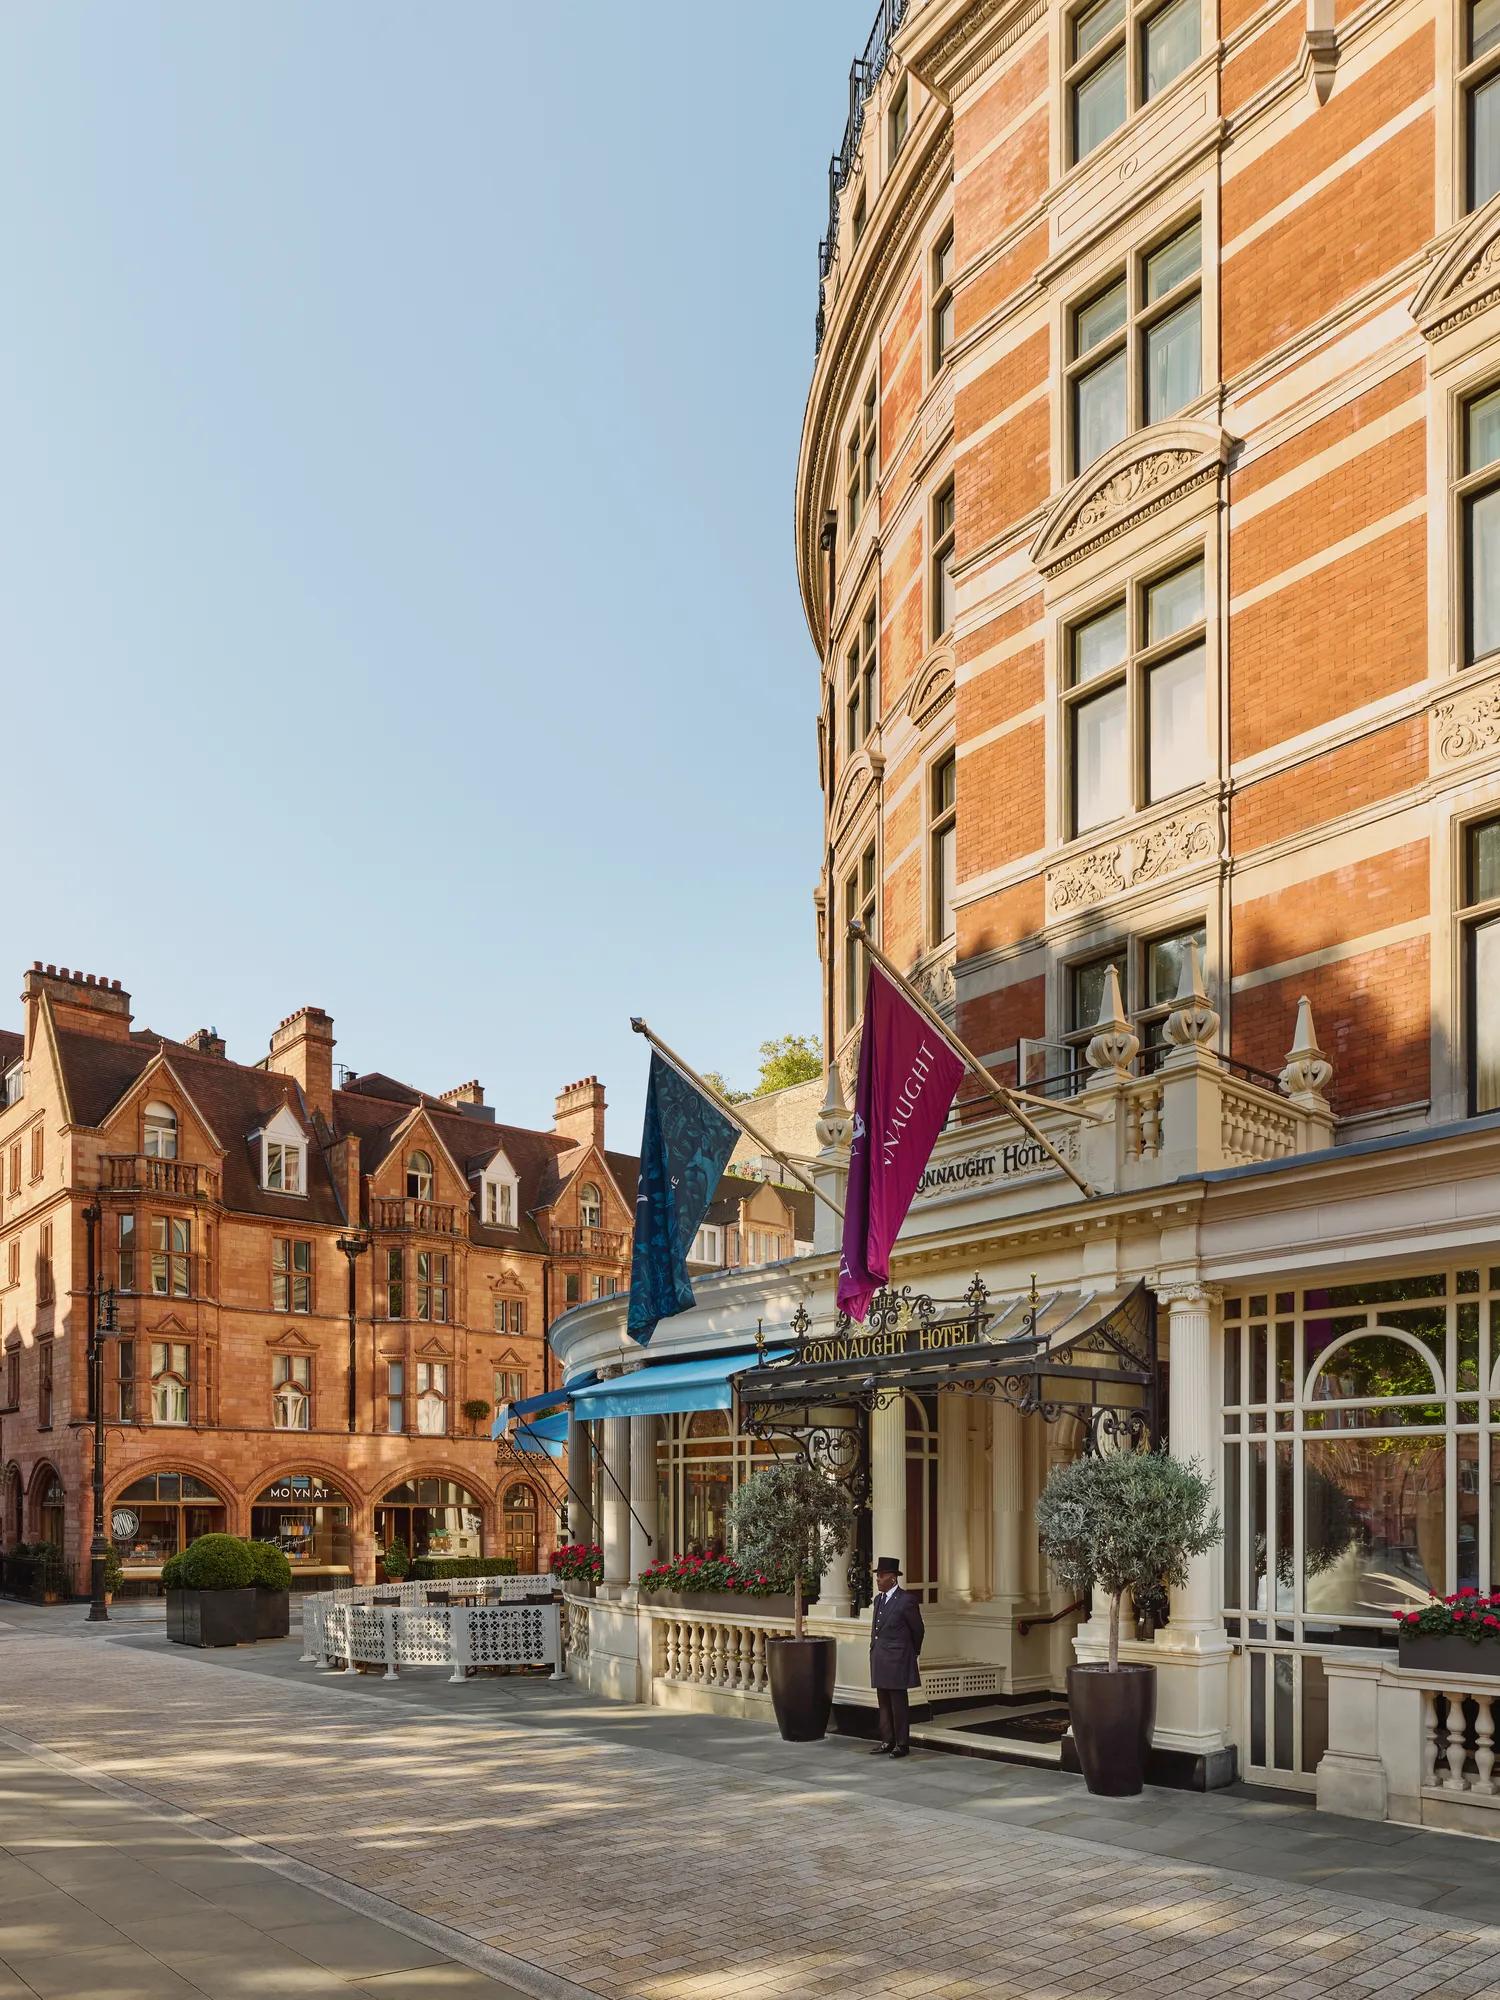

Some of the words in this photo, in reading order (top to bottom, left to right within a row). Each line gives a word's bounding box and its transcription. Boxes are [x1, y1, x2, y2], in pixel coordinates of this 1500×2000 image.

[883, 1040, 935, 1165] NAUGHT
[916, 1157, 996, 1194] ONNAUGHT
[873, 1295, 894, 1311] THE
[803, 1333, 907, 1364] CONNAUGHT
[920, 1323, 976, 1351] HOTEL
[270, 1488, 329, 1498] MOYNAT
